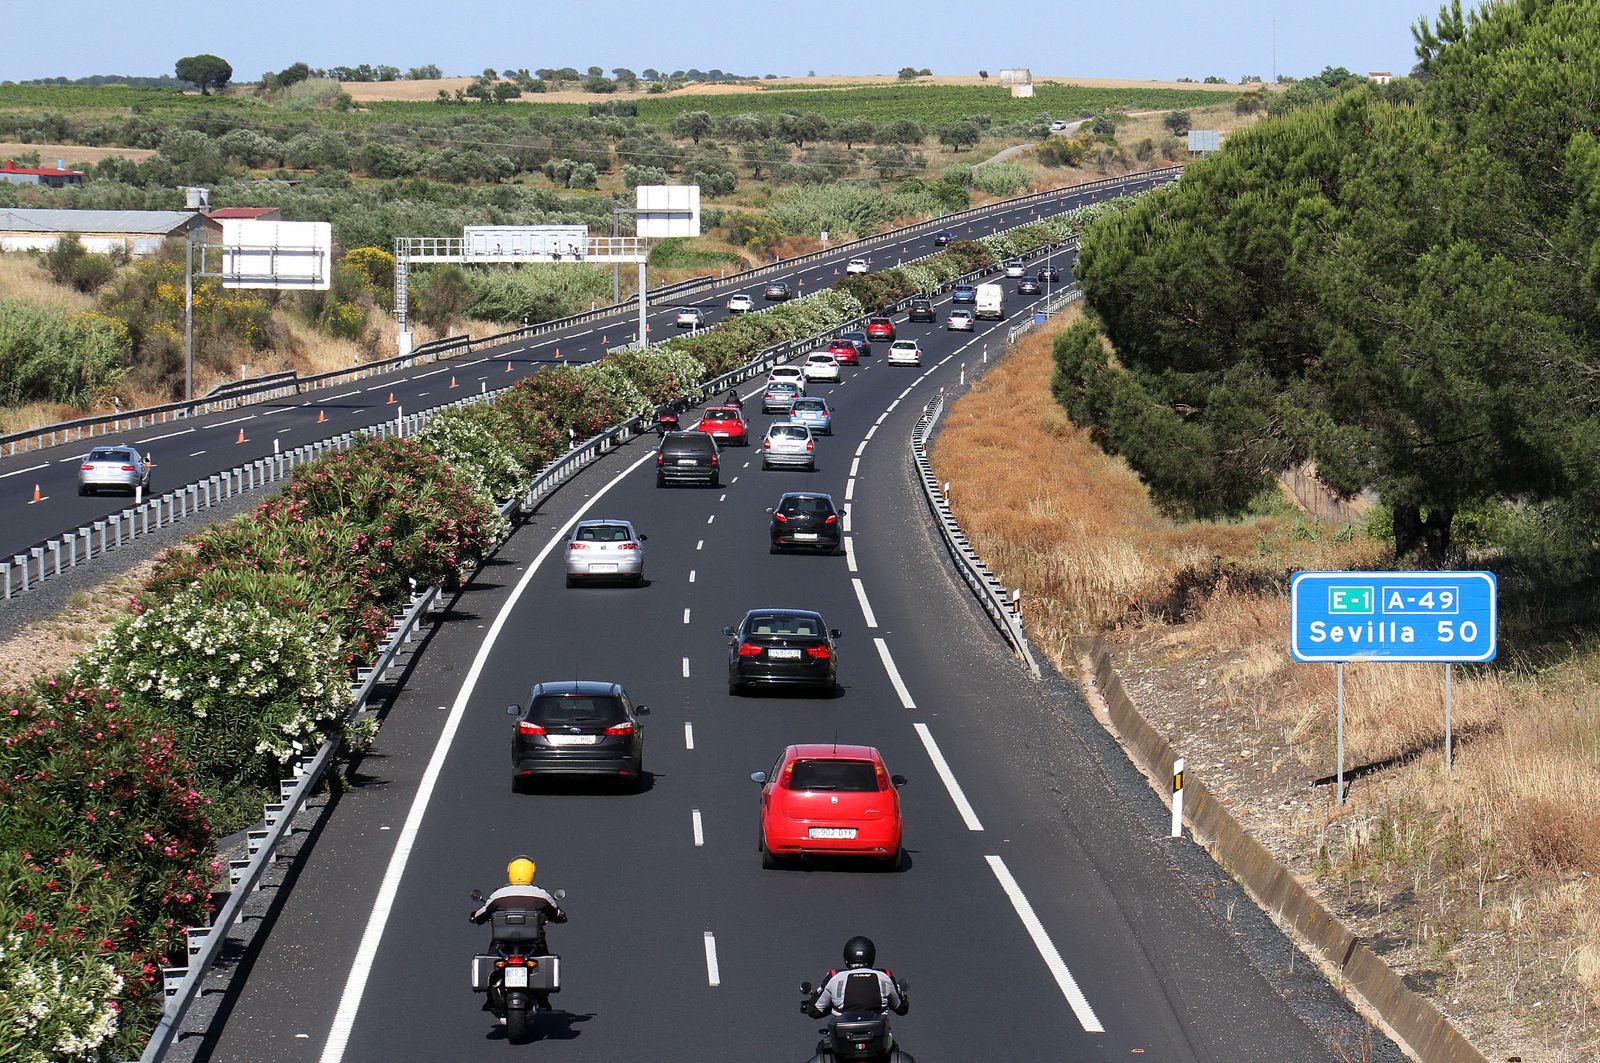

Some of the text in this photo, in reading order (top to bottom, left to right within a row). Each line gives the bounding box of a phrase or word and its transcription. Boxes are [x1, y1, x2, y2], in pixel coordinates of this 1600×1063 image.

[1333, 591, 1454, 609] E-1 A-49
[1309, 620, 1478, 643] Sevilla 50
